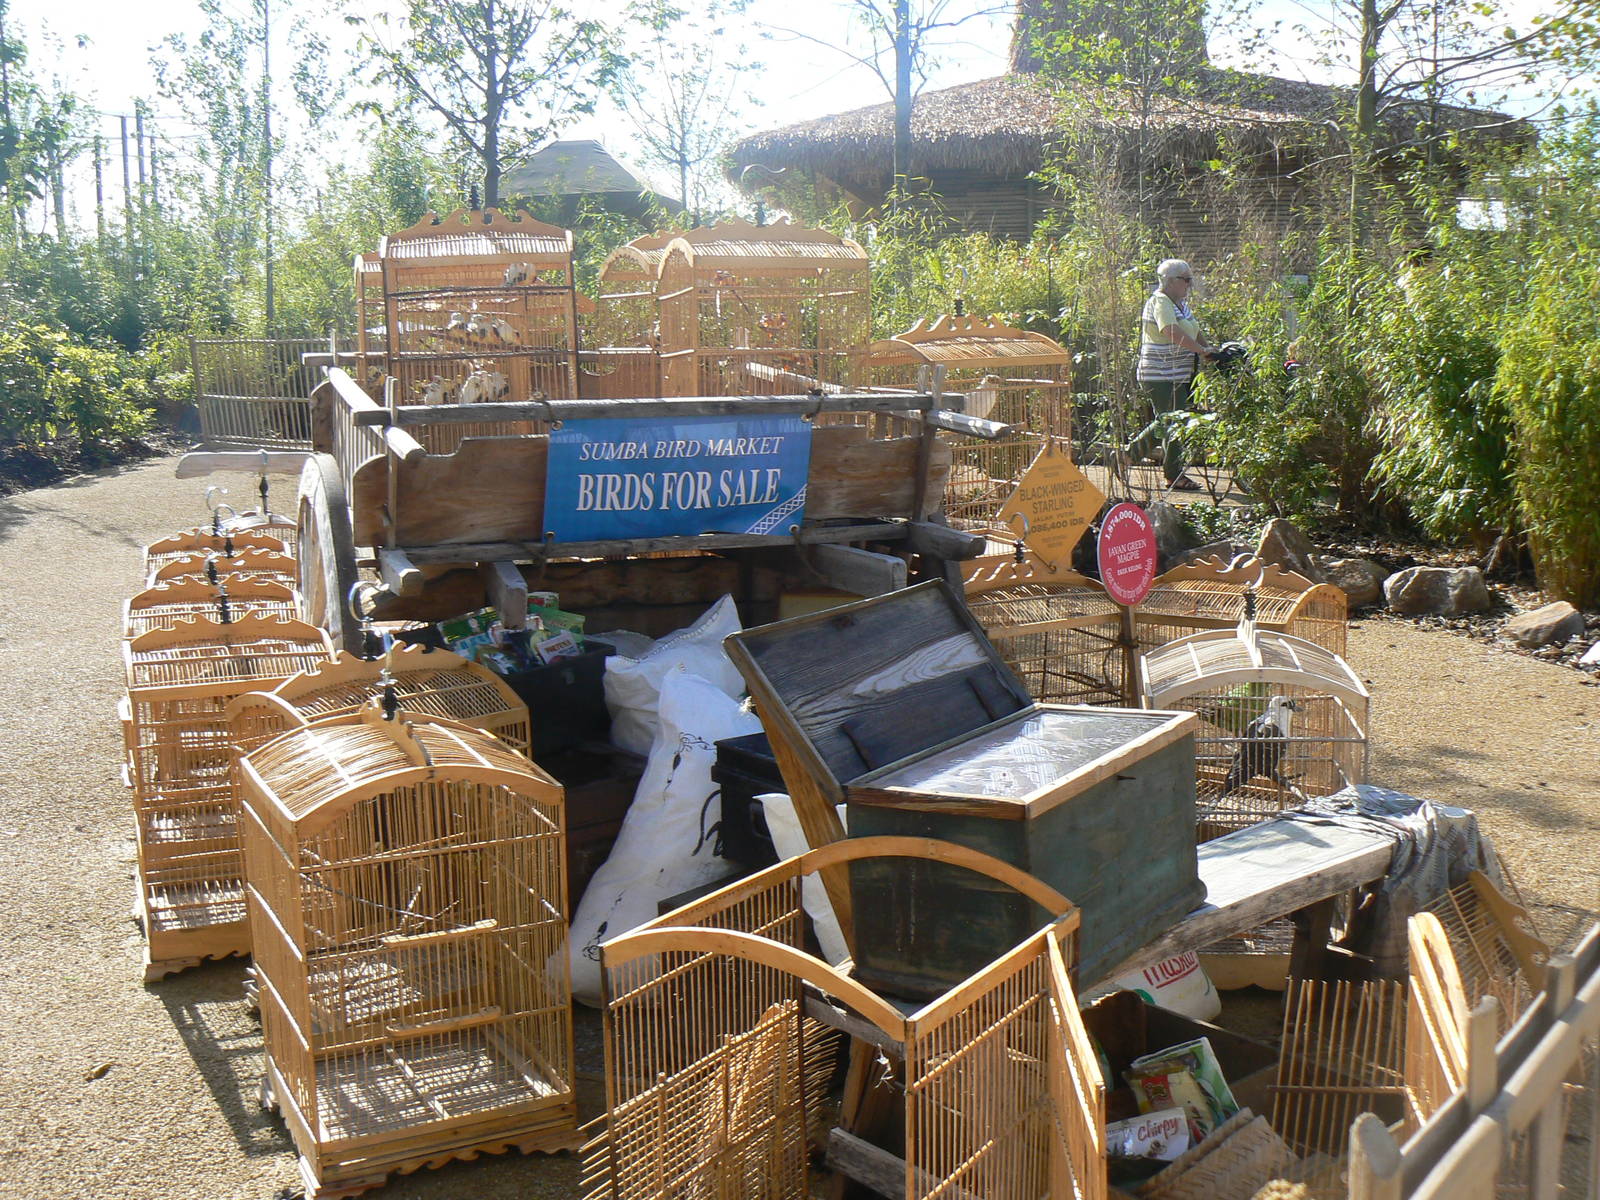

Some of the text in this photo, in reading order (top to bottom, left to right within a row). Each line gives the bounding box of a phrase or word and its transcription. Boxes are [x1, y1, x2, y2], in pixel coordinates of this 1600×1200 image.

[579, 436, 785, 461] SUMBA BIRD MARKET
[576, 468, 781, 511] BIRDS FOR SALE
[1019, 480, 1084, 502] BLACK-WINGED
[1032, 496, 1073, 514] STARLING
[1133, 512, 1146, 531] IDR
[1127, 538, 1147, 552] GREEN
[1117, 550, 1141, 564] MAGPIE
[1137, 1117, 1178, 1141] Chirpy
